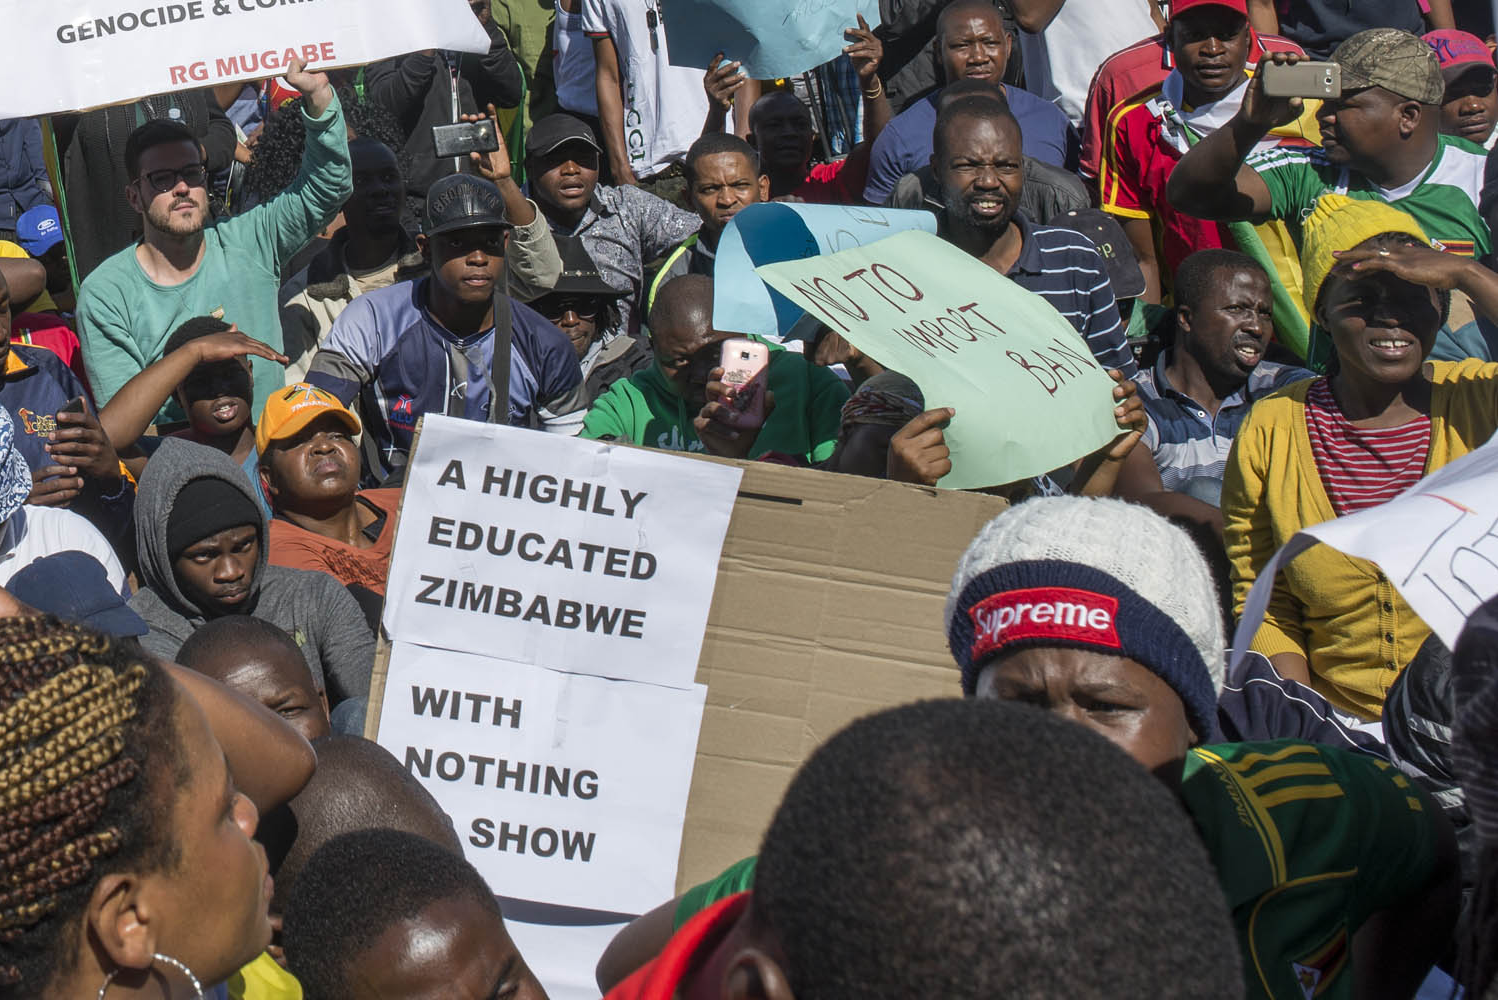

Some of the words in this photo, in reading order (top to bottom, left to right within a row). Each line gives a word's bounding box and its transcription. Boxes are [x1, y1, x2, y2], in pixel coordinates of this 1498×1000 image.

[56, 0, 204, 44] GENOCIDE
[169, 61, 209, 85] RG
[216, 41, 336, 77] MUGABE
[791, 277, 869, 332] NO
[843, 263, 924, 314] TO
[893, 302, 1007, 359] IMPORT
[1006, 338, 1097, 398] BAN
[437, 459, 466, 490] A
[481, 465, 648, 519] HIGHLY
[428, 516, 657, 580] EDUCATED
[414, 574, 647, 639] ZIMBABWE
[976, 602, 1111, 643] Supreme
[411, 685, 522, 728] WITH
[404, 746, 599, 800] NOTHING
[469, 817, 596, 862] SHOW
